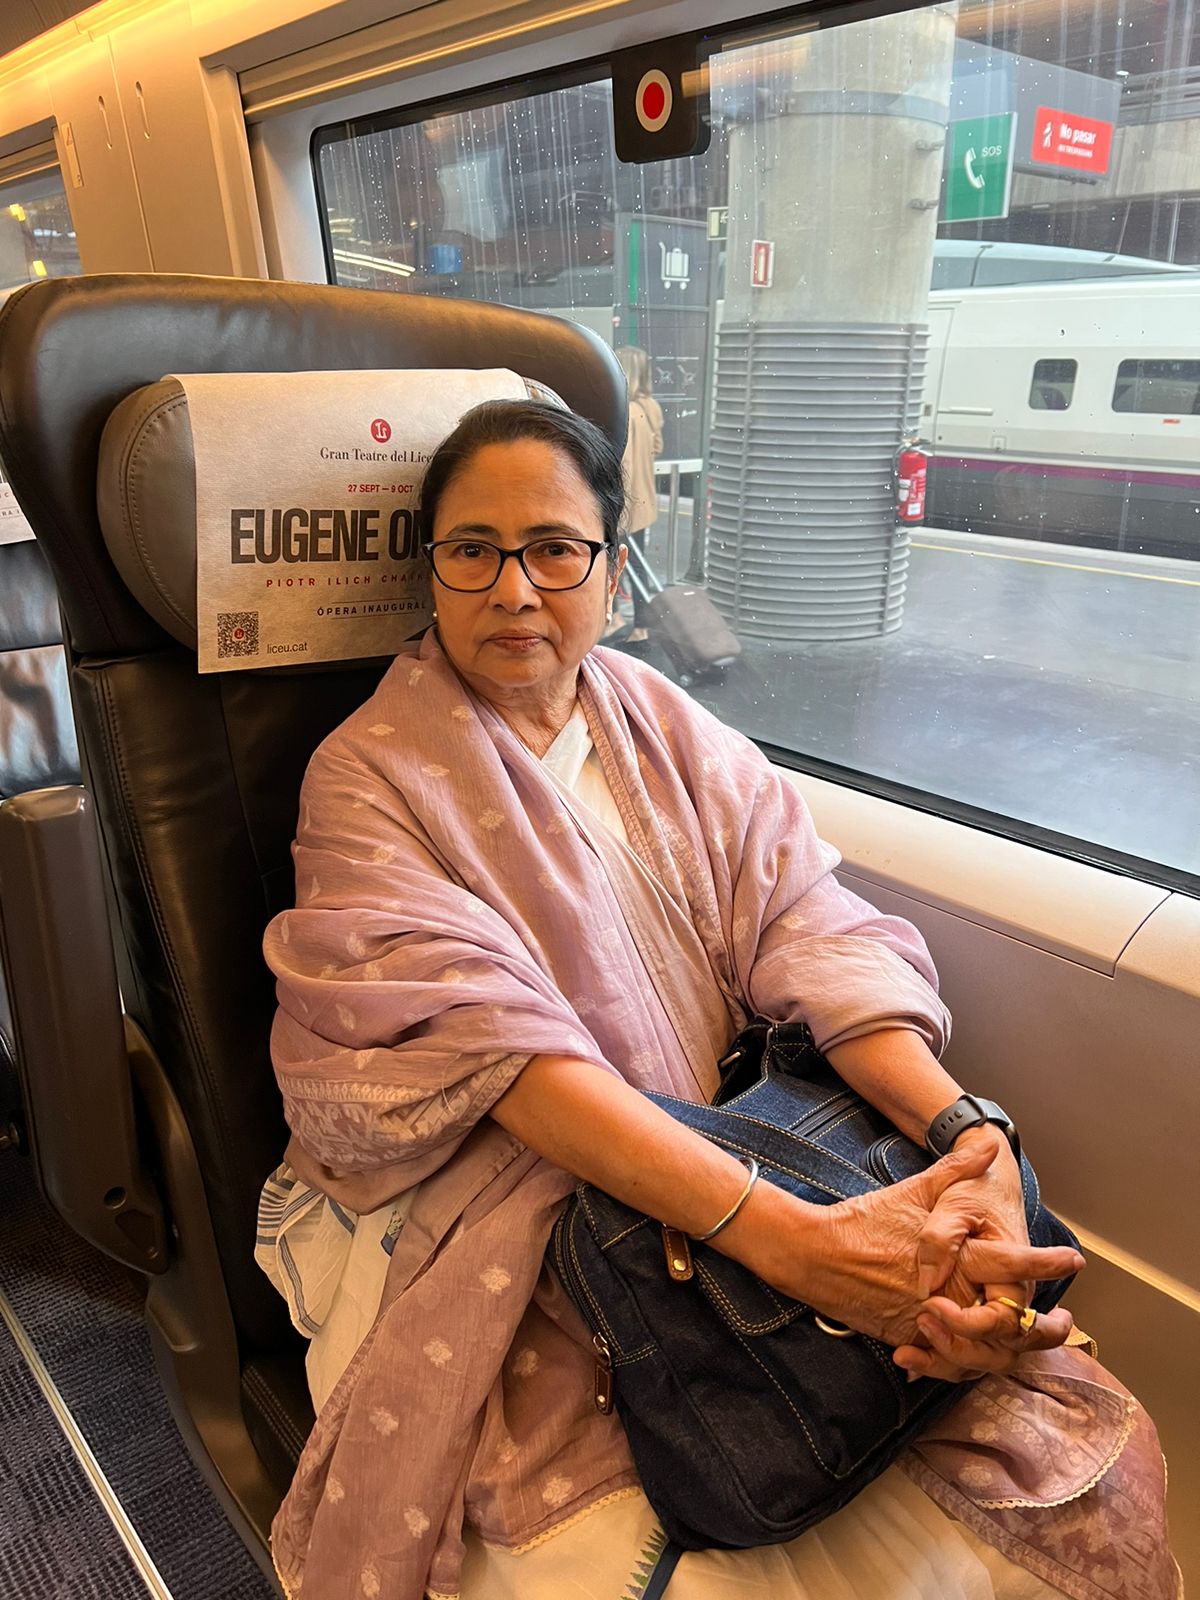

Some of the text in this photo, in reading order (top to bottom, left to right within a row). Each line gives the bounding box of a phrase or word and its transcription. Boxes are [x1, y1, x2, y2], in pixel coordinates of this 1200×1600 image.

[1060, 122, 1096, 145] No pasar
[982, 145, 1002, 157] SOS
[320, 447, 433, 463] Gran Teatre del Lice
[348, 484, 358, 493] 27
[359, 484, 380, 494] SEPT
[391, 485, 396, 494] 9
[397, 484, 414, 494] OCT
[231, 508, 380, 564] EUGENE
[266, 578, 316, 588] PIOTR
[327, 576, 372, 586] ILICH
[317, 602, 427, 616] ÓPERA INAUGURAL
[266, 642, 308, 654] liceu.cat
